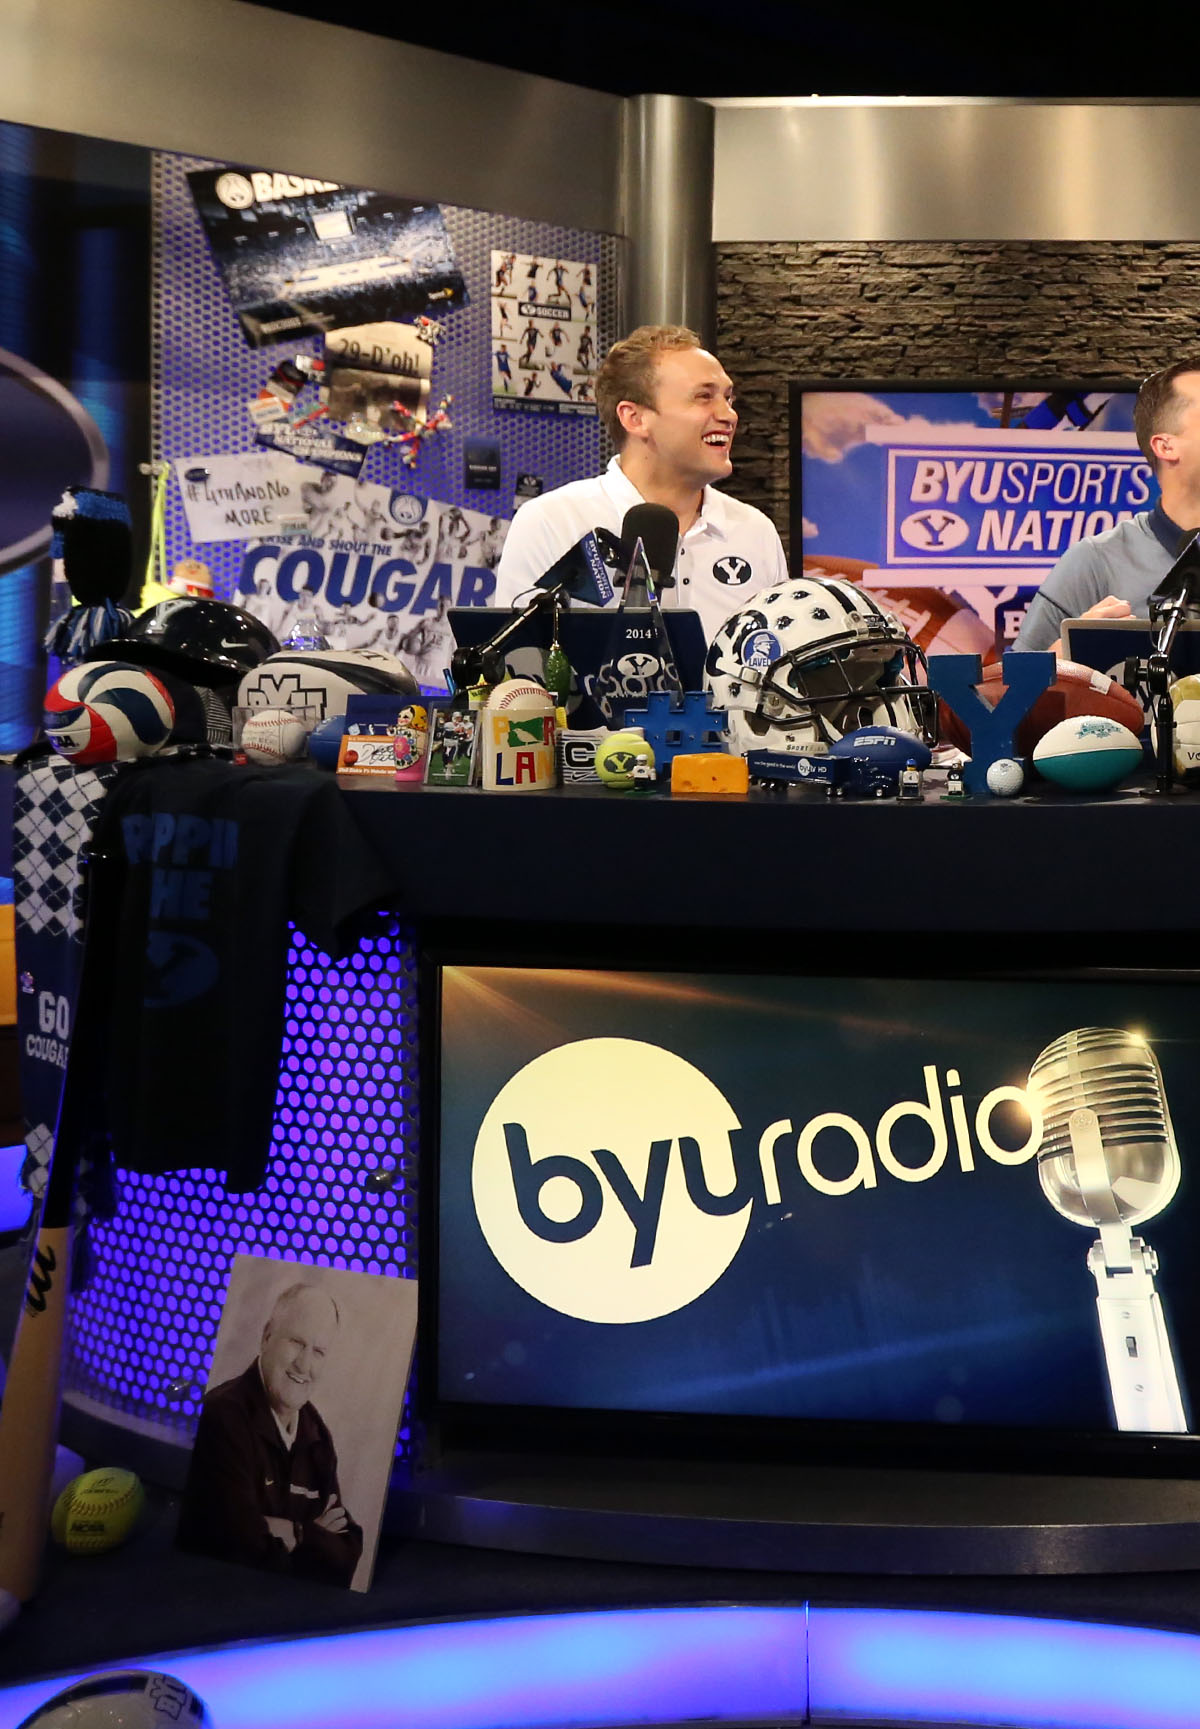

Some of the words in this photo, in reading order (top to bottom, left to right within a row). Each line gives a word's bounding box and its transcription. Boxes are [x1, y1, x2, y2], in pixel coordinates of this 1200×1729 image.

[536, 305, 570, 319] SOCCER
[340, 338, 420, 374] 29-D'oh!
[225, 505, 274, 528] MORE
[298, 534, 325, 549] AND
[329, 539, 369, 554] SHOUT
[372, 543, 393, 557] THE
[239, 545, 497, 615] COUGAR
[626, 629, 652, 639] 2014
[853, 736, 897, 747] ESPN
[38, 990, 70, 1041] GO
